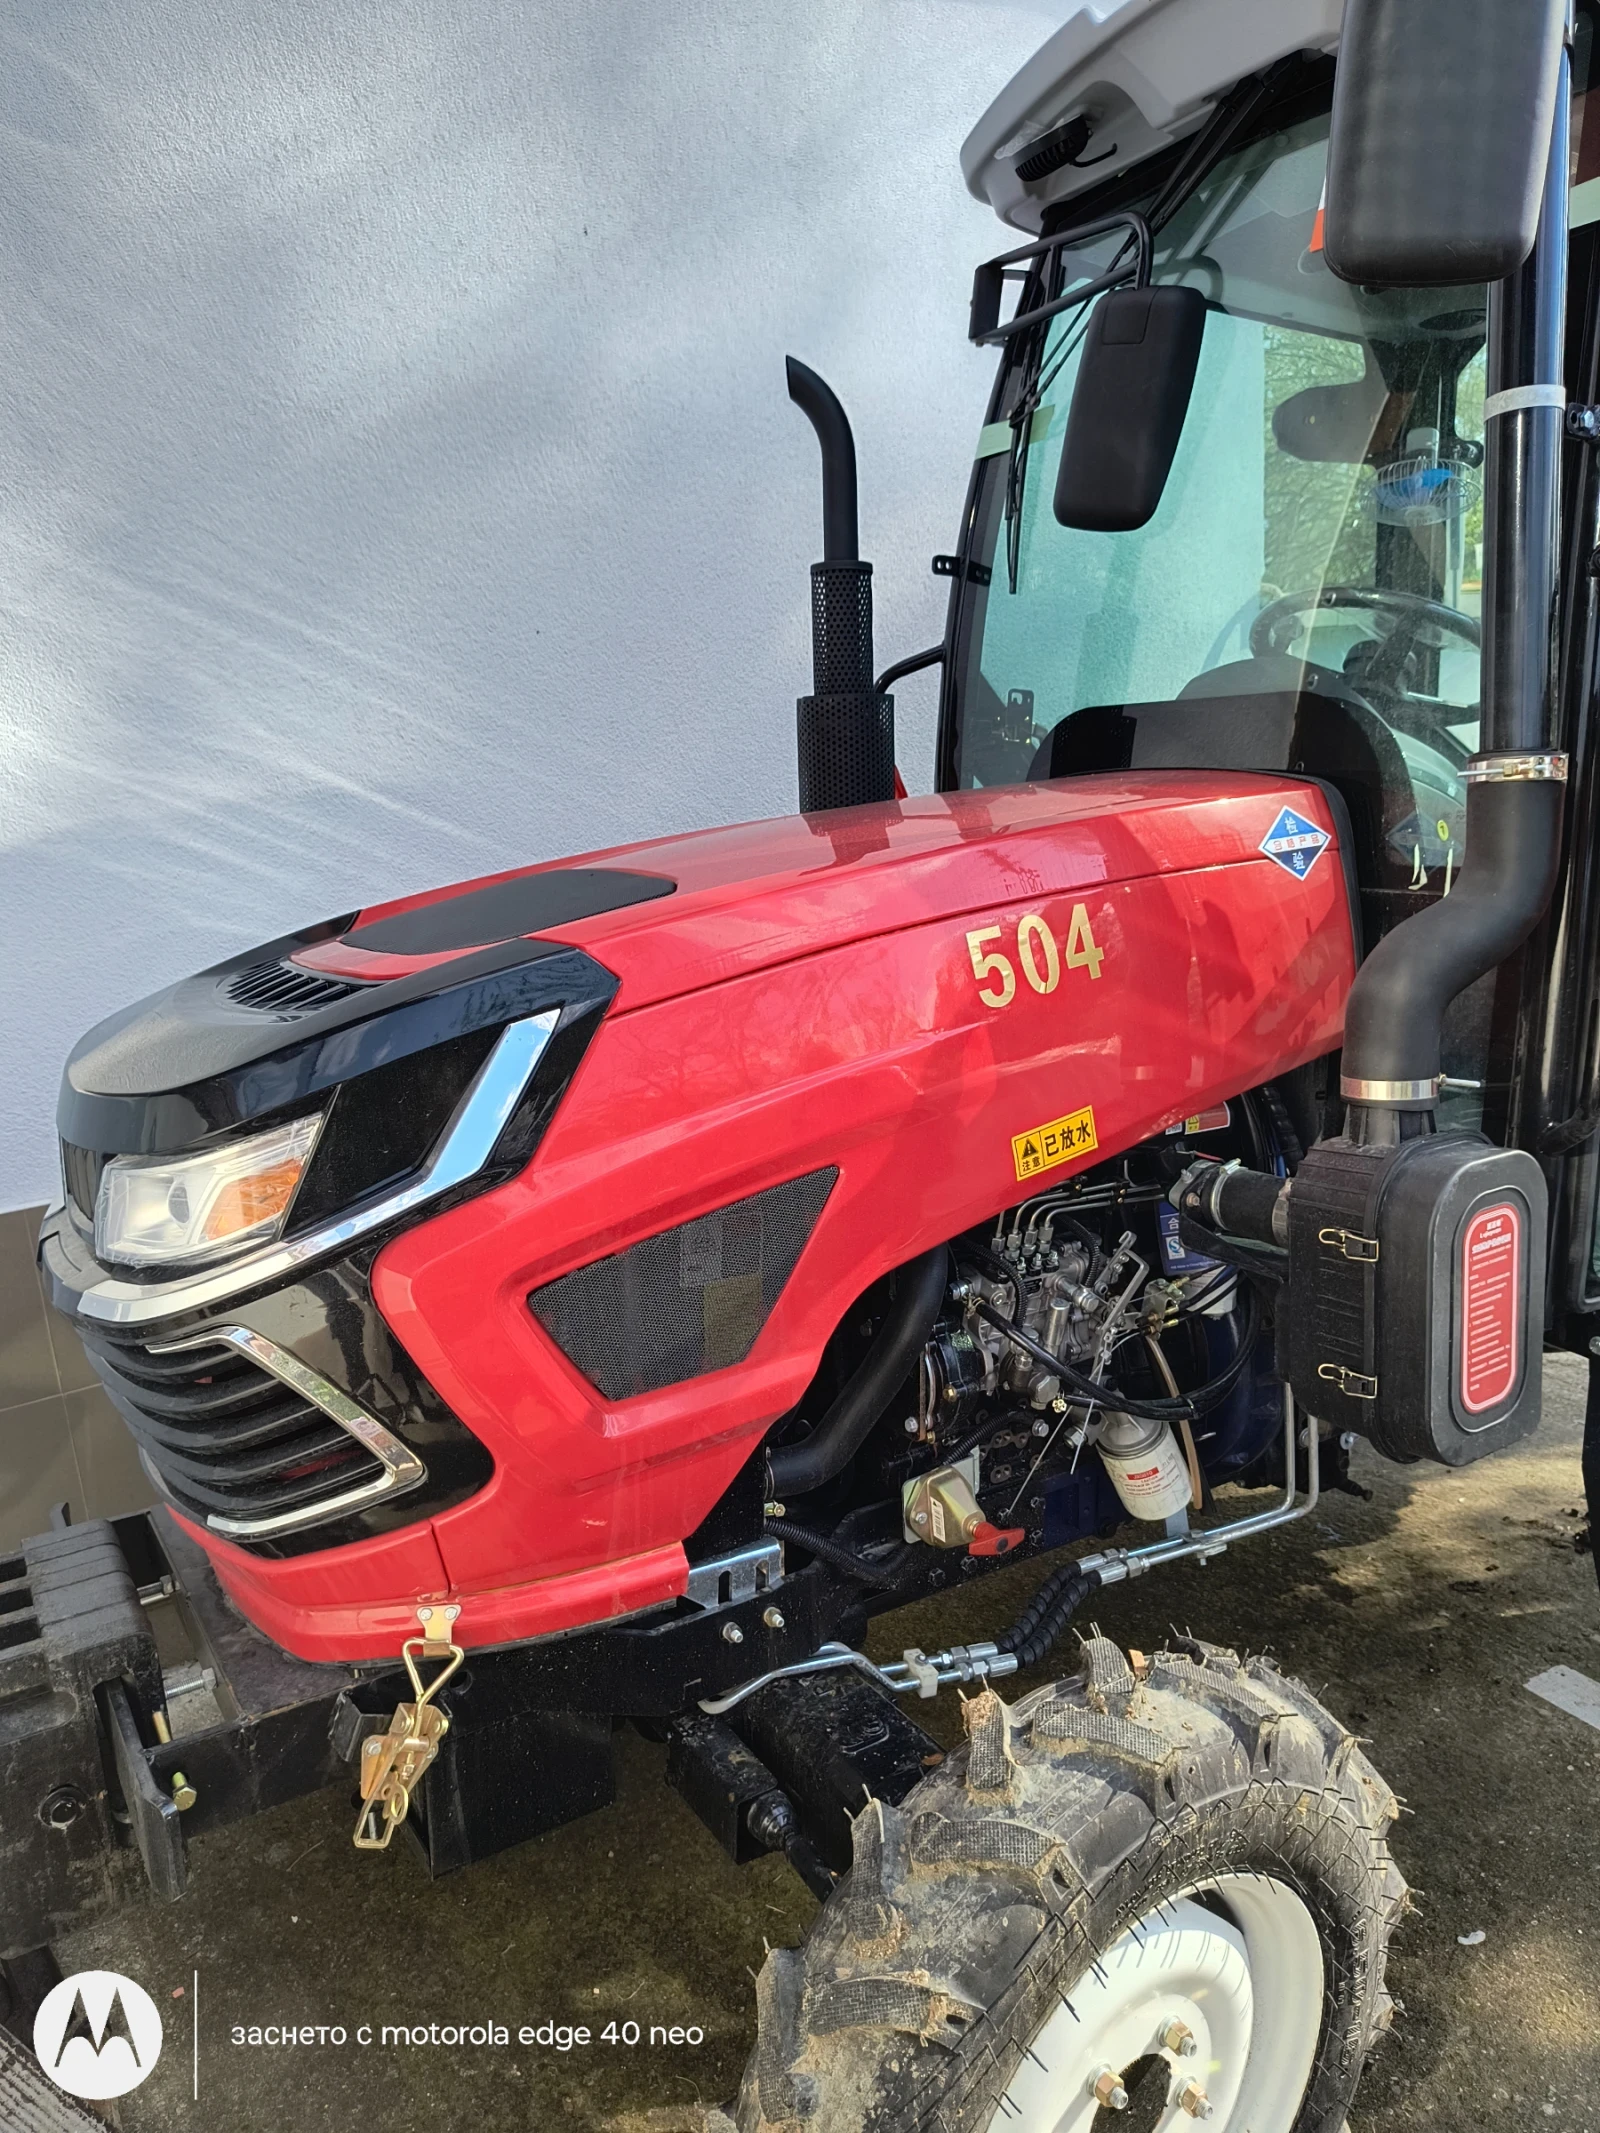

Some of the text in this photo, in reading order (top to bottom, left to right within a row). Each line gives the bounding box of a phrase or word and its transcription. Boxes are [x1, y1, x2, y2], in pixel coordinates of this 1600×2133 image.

[966, 903, 1104, 1008] 504
[1044, 1120, 1091, 1157] 已放水
[1022, 1156, 1041, 1172] 注意
